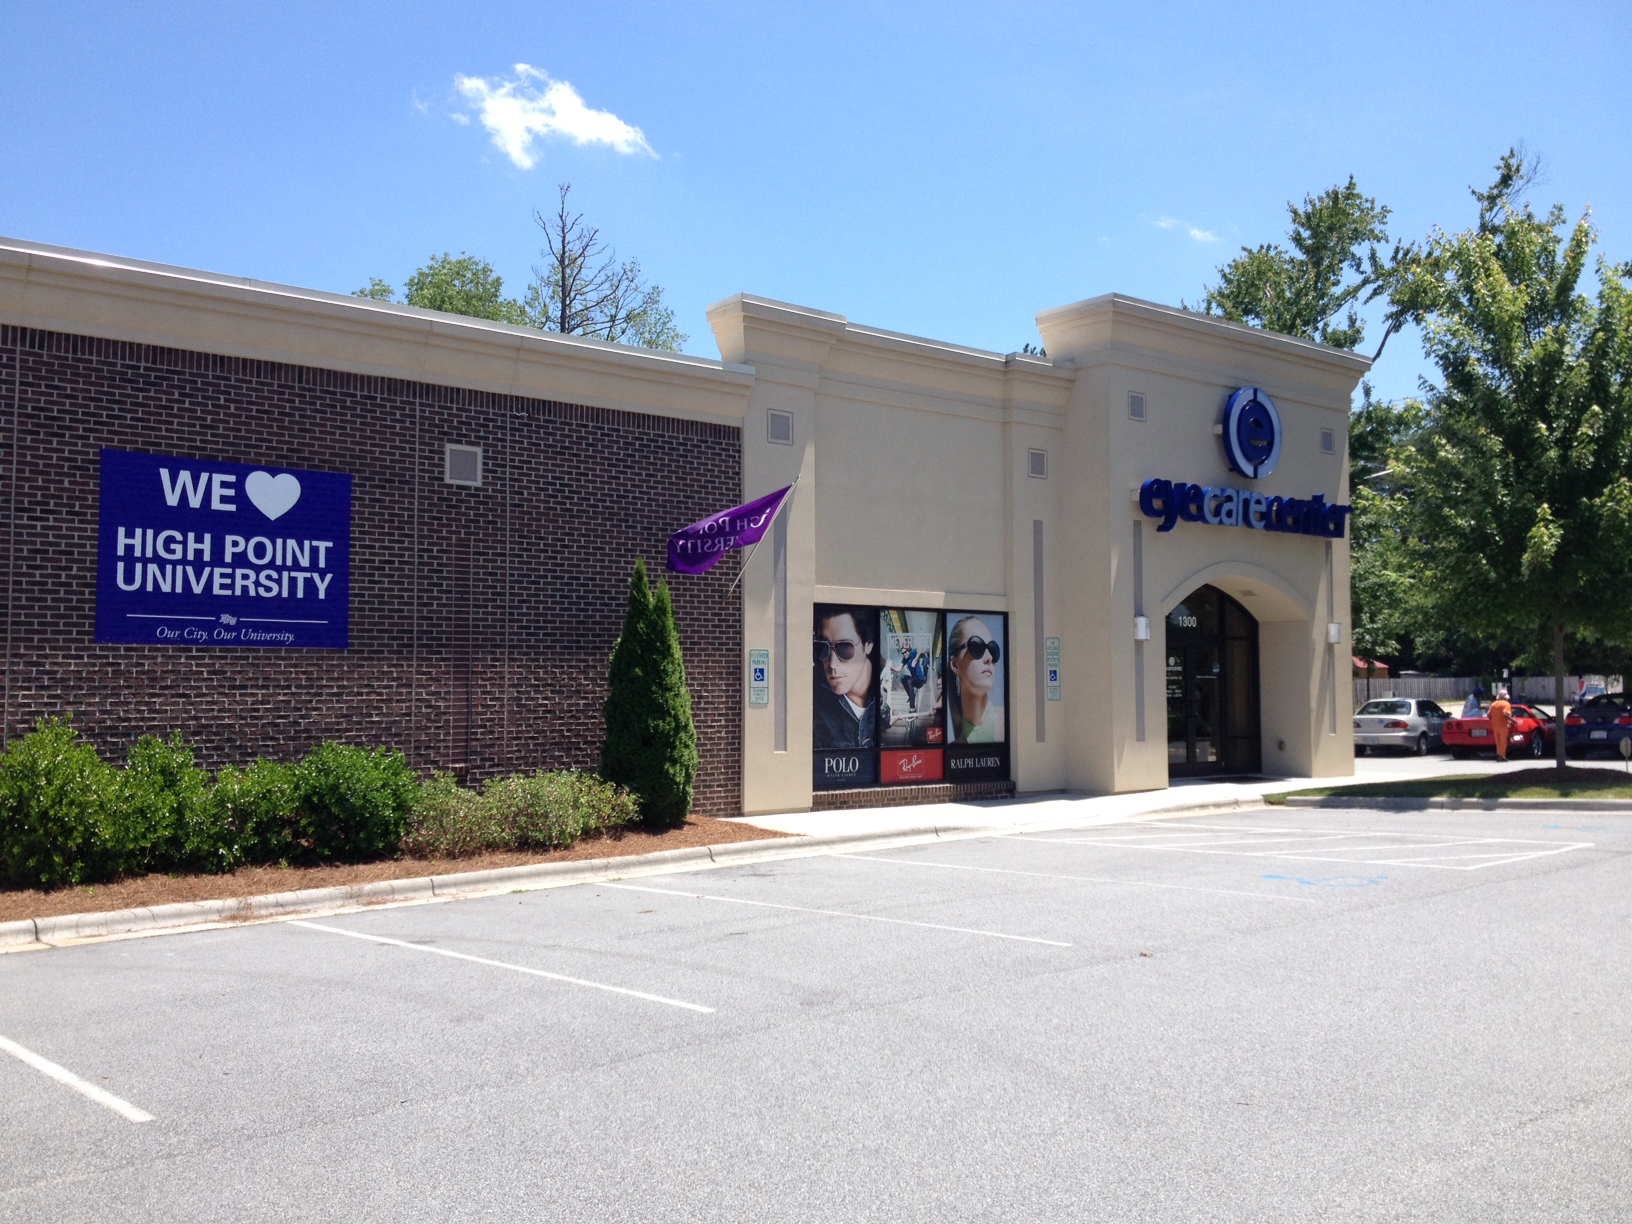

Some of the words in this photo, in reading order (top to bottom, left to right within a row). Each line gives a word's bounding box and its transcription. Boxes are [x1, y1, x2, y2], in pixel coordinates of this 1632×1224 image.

[159, 467, 236, 511] WE
[116, 526, 212, 561] HIGH
[224, 534, 334, 569] POINT
[116, 561, 334, 600] UNIVERSITY
[1178, 615, 1197, 628] 1300
[156, 626, 181, 638] Our
[184, 626, 209, 643] City.
[213, 628, 237, 640] Our
[240, 628, 295, 645] University.
[824, 756, 859, 774] POLO
[950, 758, 974, 769] RALPH
[975, 756, 1001, 768] LAUREN
